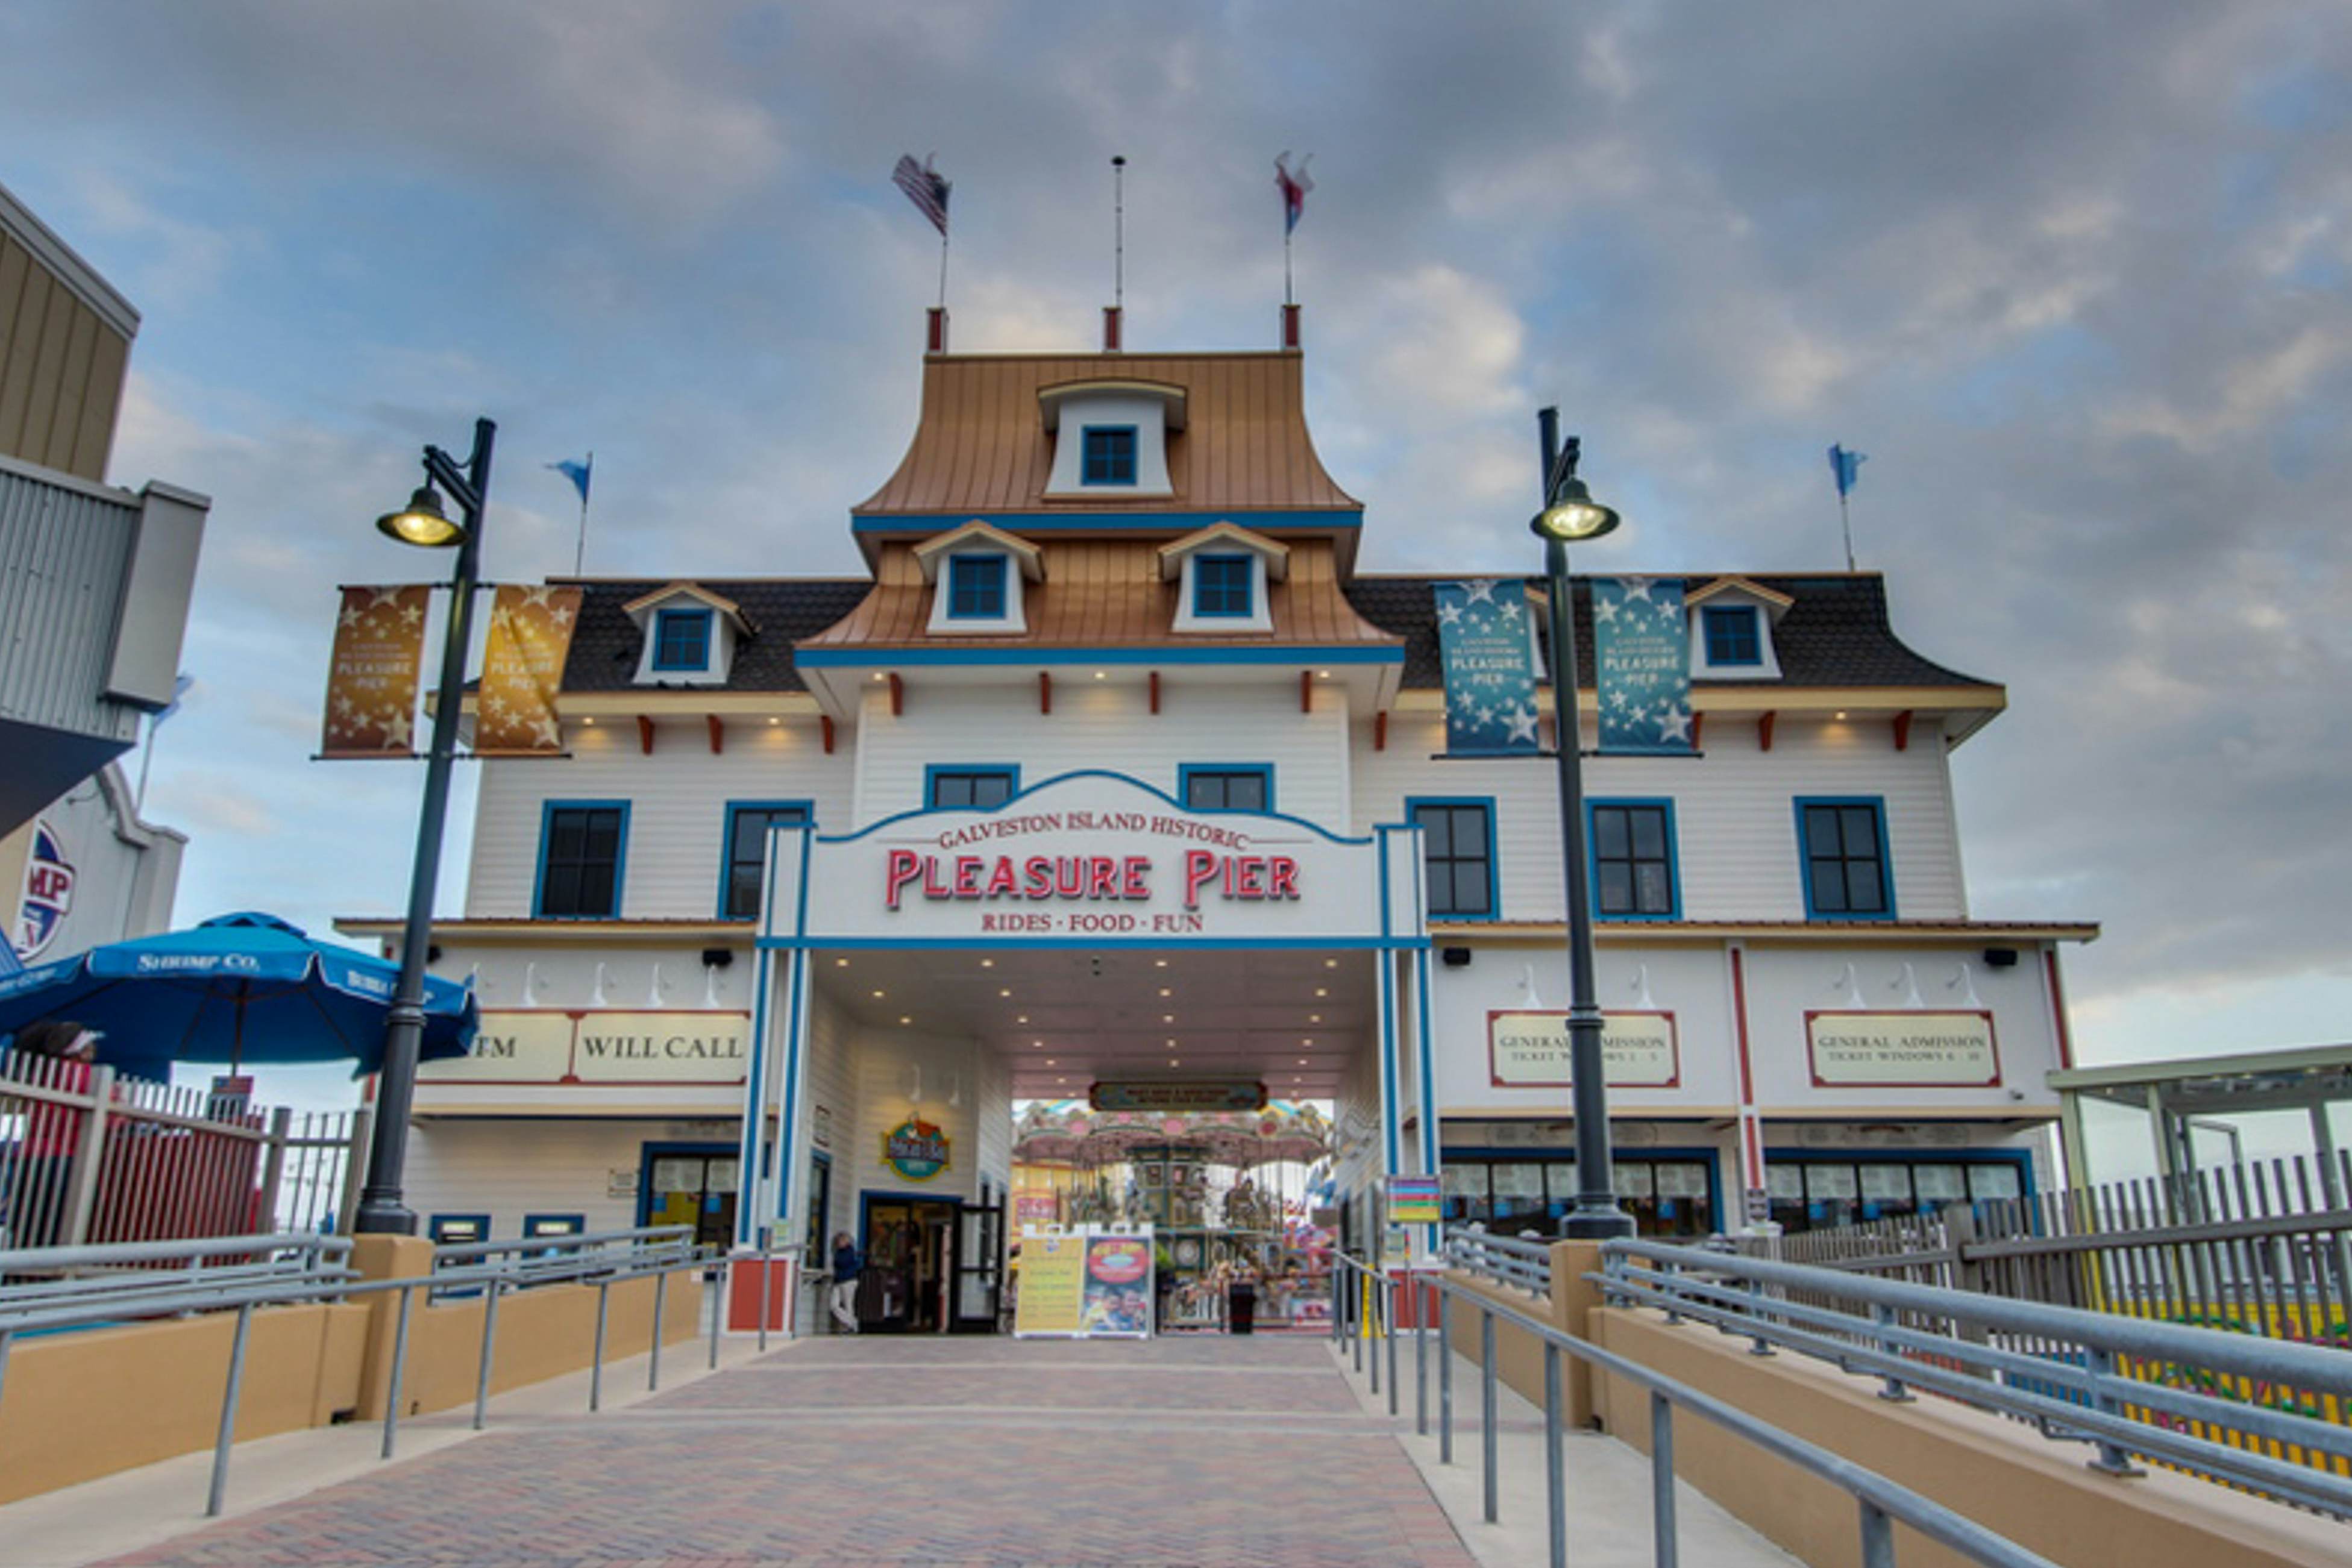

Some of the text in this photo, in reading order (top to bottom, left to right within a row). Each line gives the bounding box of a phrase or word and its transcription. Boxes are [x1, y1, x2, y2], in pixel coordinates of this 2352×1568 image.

[339, 662, 413, 674] PLEASURE
[1451, 657, 1524, 671] PLEASURE
[1604, 657, 1679, 671] PLEASURE
[939, 811, 1251, 851] GALVESTON ISLAND HISTORIC
[886, 849, 1300, 911] PLEASURE PIER
[982, 913, 1203, 933] RIDES FOOD FUN
[583, 1035, 745, 1059] WILL CALL
[1602, 1036, 1666, 1048] MISSION
[1817, 1035, 1986, 1049] GENERAL ADMISSION
[1511, 1052, 1555, 1061] TICKET
[1828, 1052, 1872, 1061] TICKET
[1877, 1052, 1943, 1061] WINDOWS
